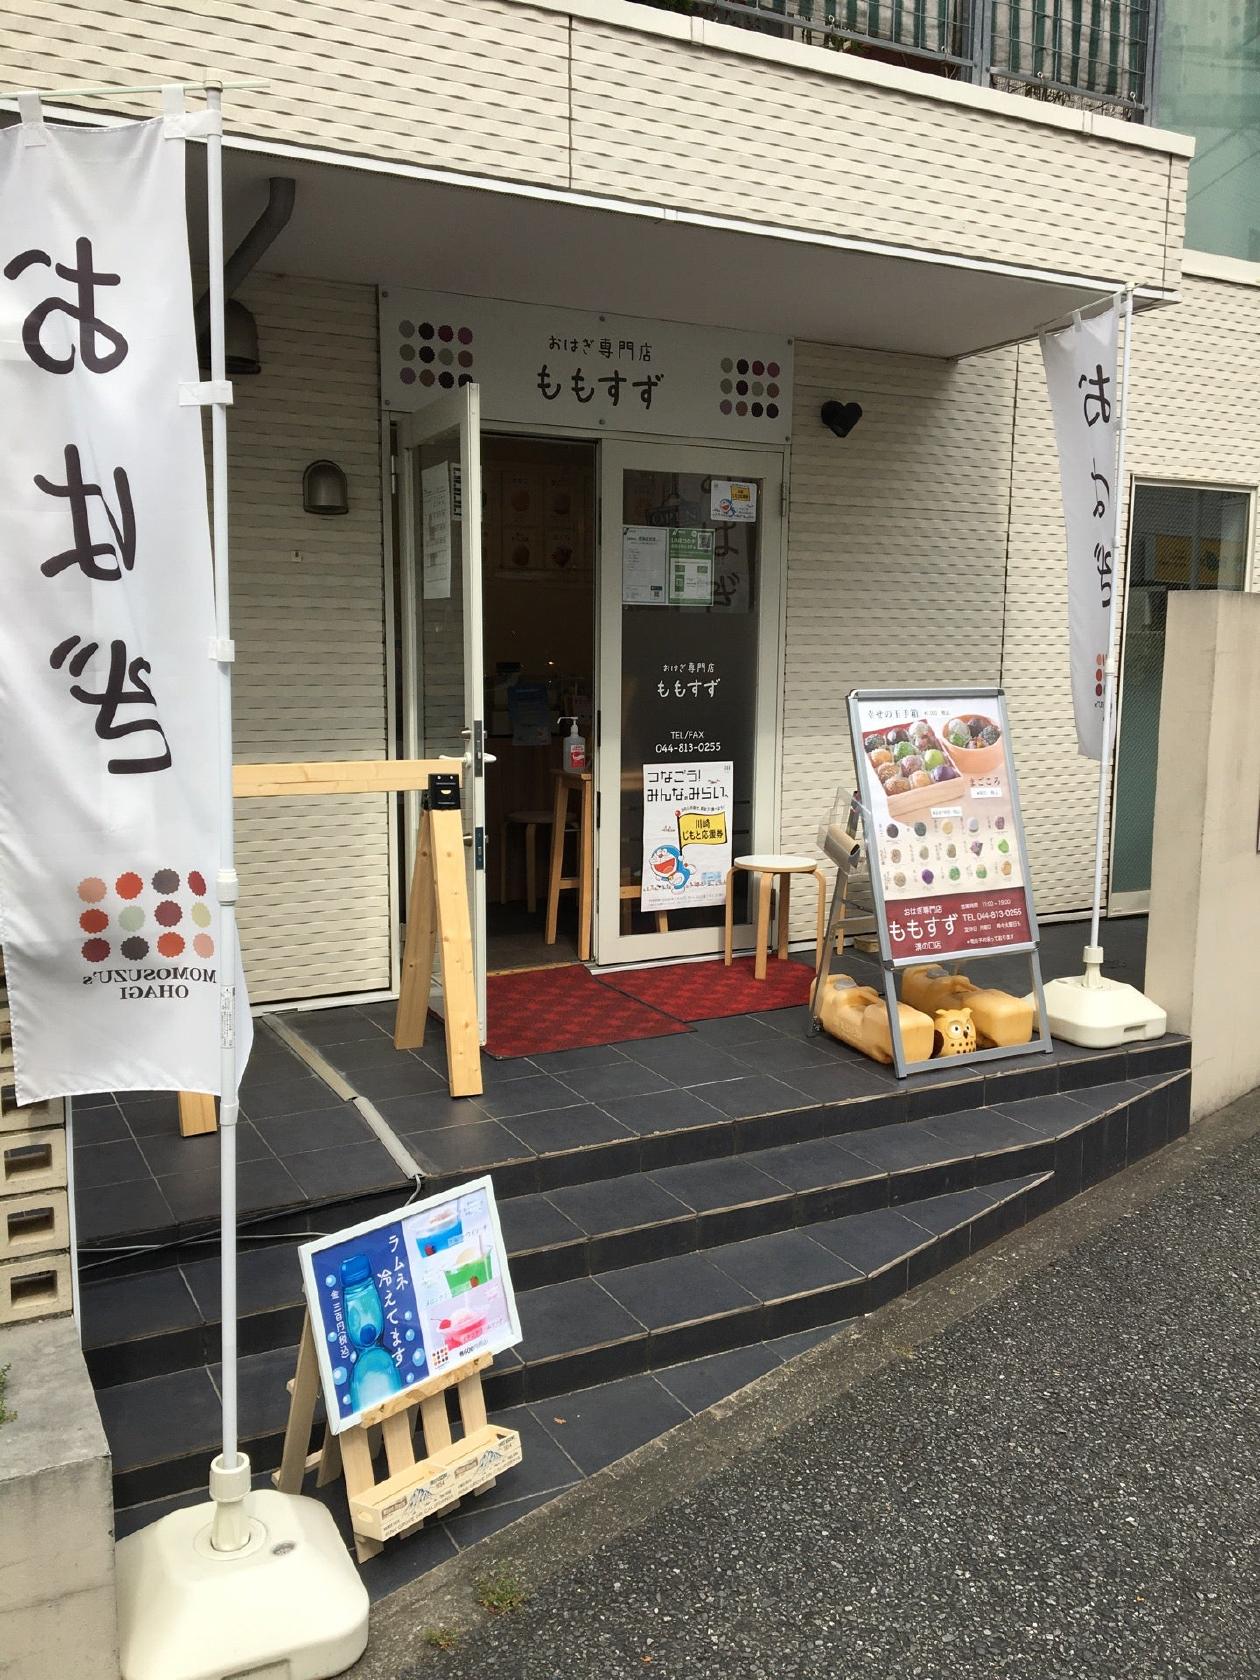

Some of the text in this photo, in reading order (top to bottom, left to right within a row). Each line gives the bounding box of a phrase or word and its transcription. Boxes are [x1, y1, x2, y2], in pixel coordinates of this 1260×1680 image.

[548, 335, 653, 362] おはぎ専門店
[537, 364, 664, 410] ももすず
[663, 662, 715, 674] おはぎ専門店
[657, 678, 721, 698] ももすず
[671, 731, 704, 740] TEL/FAX
[655, 742, 721, 754] 044-813-0255
[695, 818, 711, 829] 川崎
[962, 908, 1022, 922] TEL 044-813-0255
[889, 913, 959, 942] ももすず
[387, 1233, 409, 1292] ラムネ
[376, 1268, 406, 1368] 冷えてます
